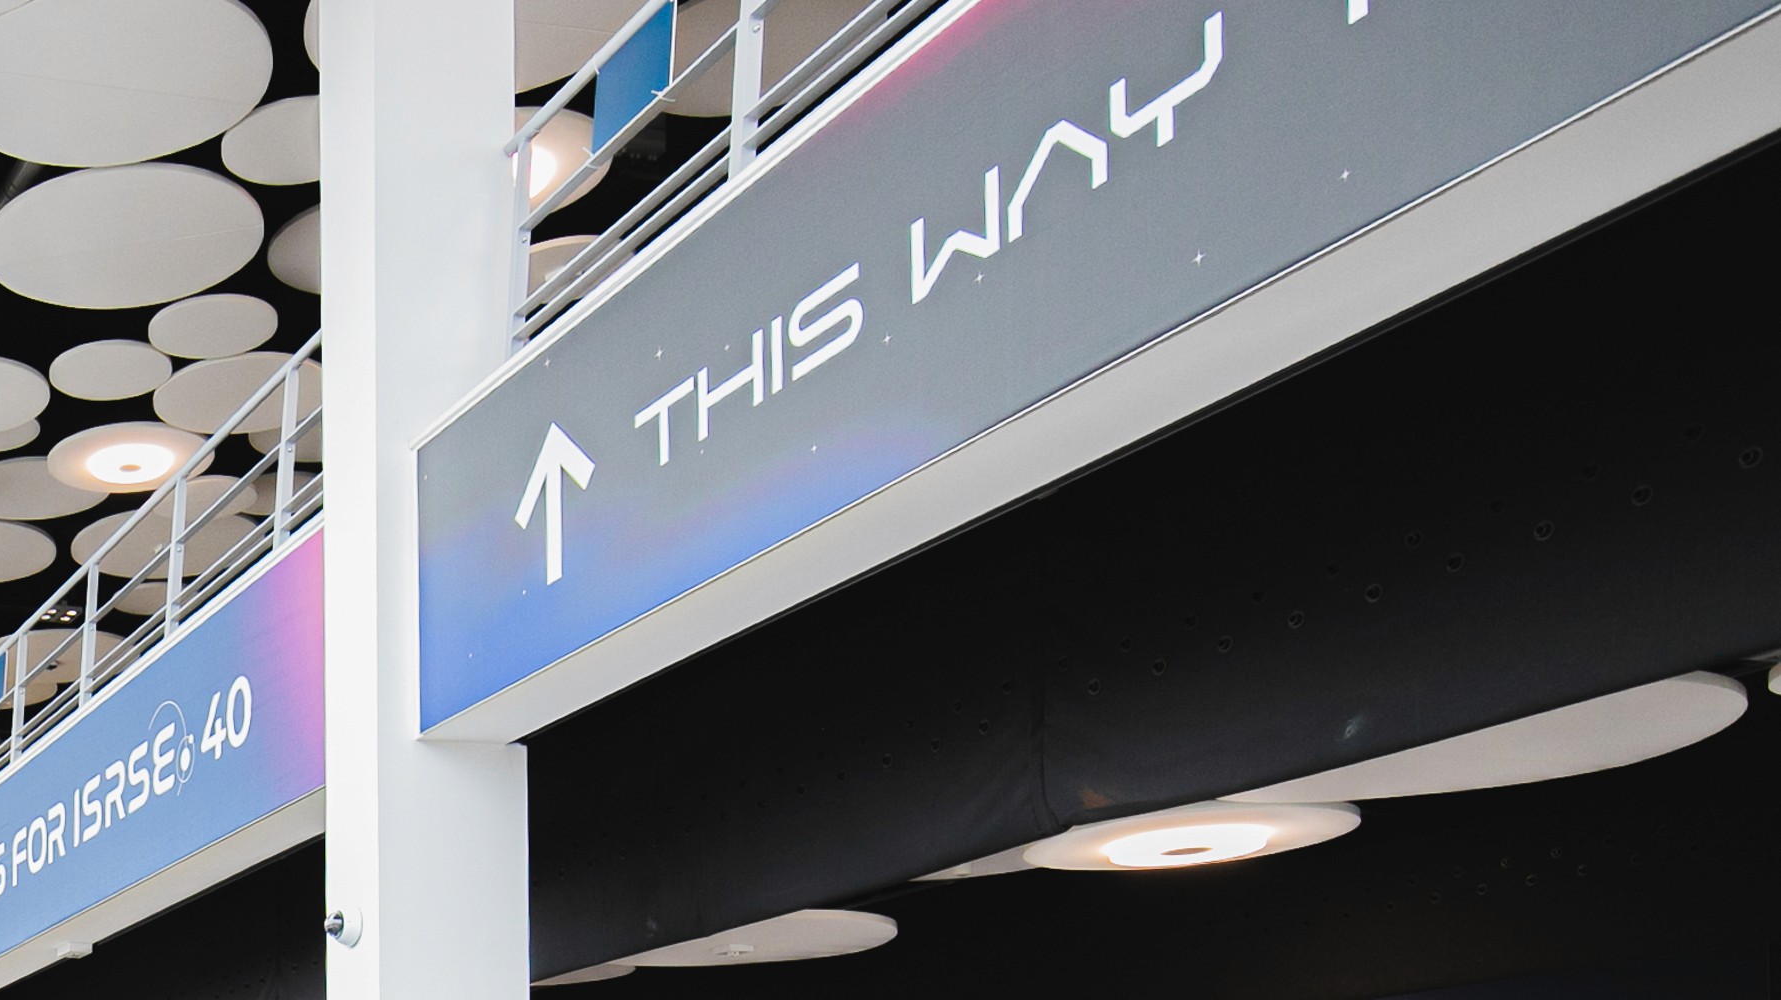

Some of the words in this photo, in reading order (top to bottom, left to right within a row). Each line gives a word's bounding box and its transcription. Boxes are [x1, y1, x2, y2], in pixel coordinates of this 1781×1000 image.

[634, 261, 864, 466] THIS
[910, 10, 1223, 305] WAY
[12, 801, 66, 888] FOR
[200, 675, 252, 760] 40
